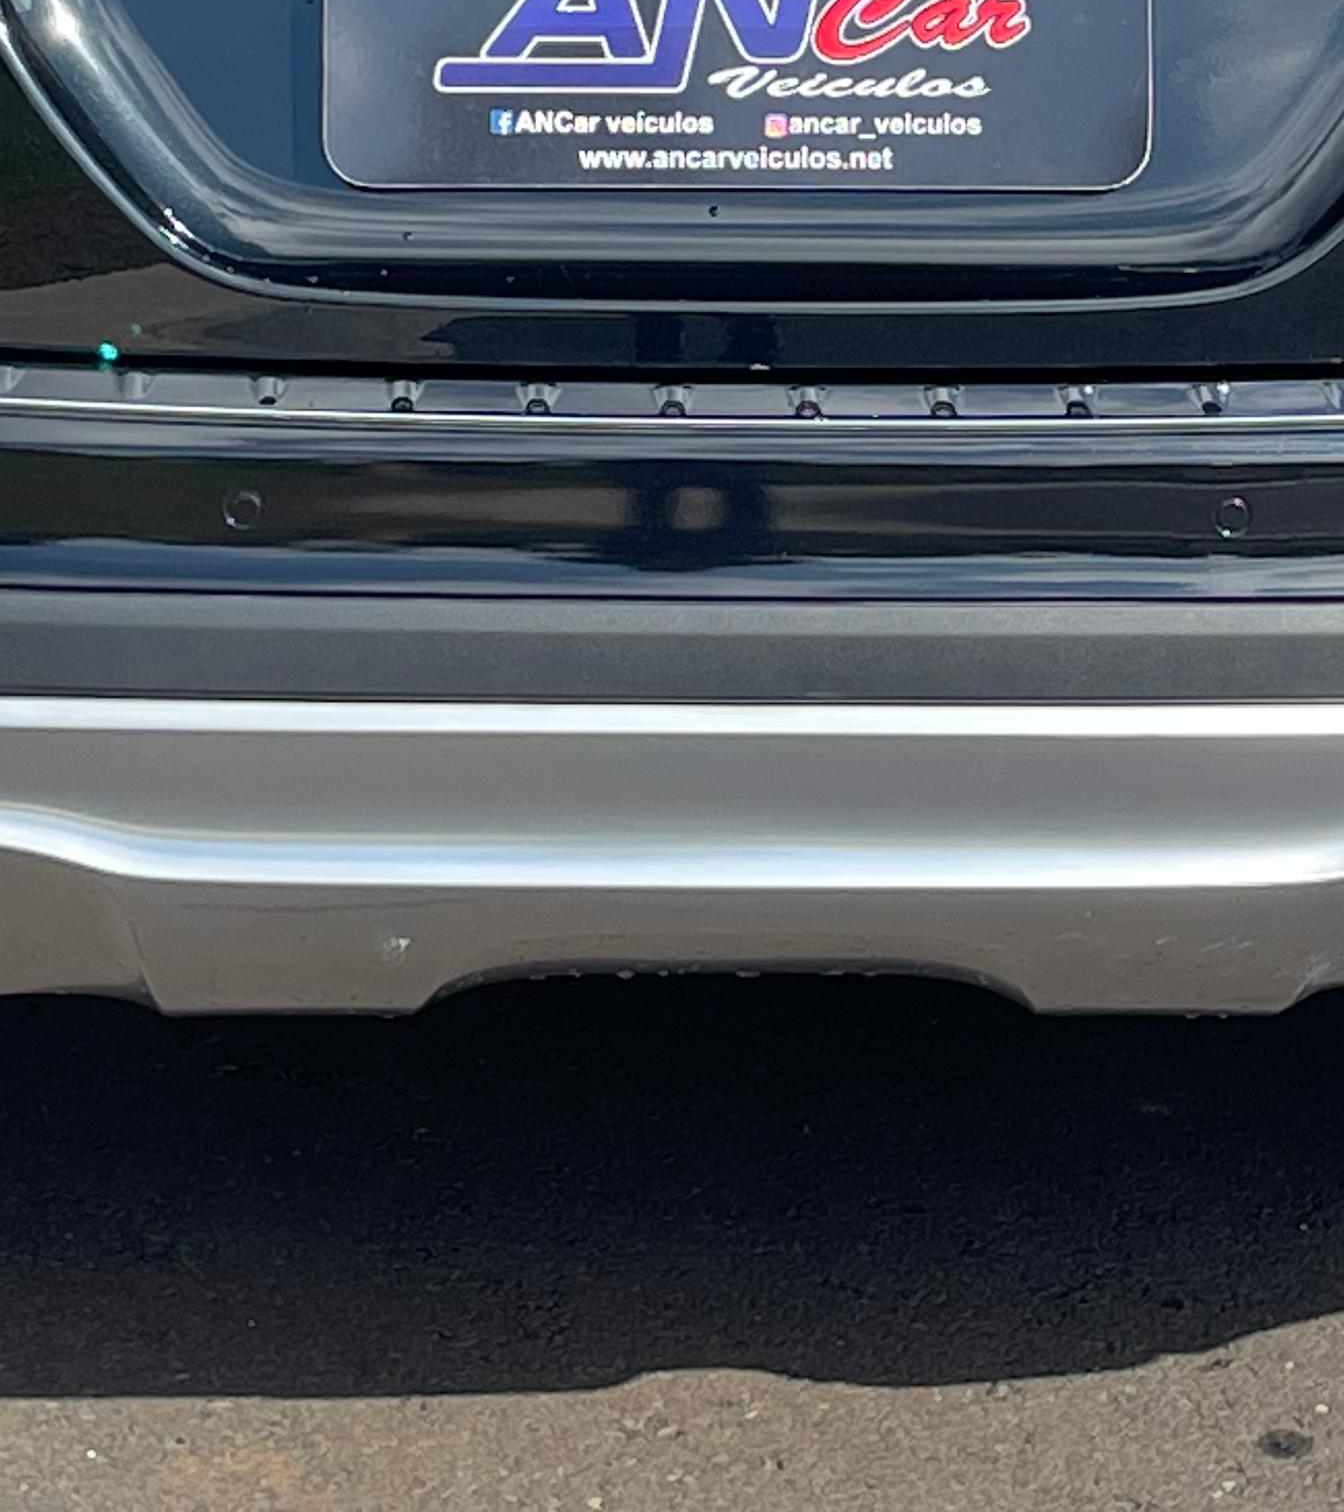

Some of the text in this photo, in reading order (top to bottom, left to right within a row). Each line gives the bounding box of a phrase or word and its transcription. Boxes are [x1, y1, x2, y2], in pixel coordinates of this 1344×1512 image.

[515, 109, 602, 135] ANCar
[787, 111, 984, 140] ancar_veiculos
[578, 145, 895, 171] www.ancarveiculos.net
